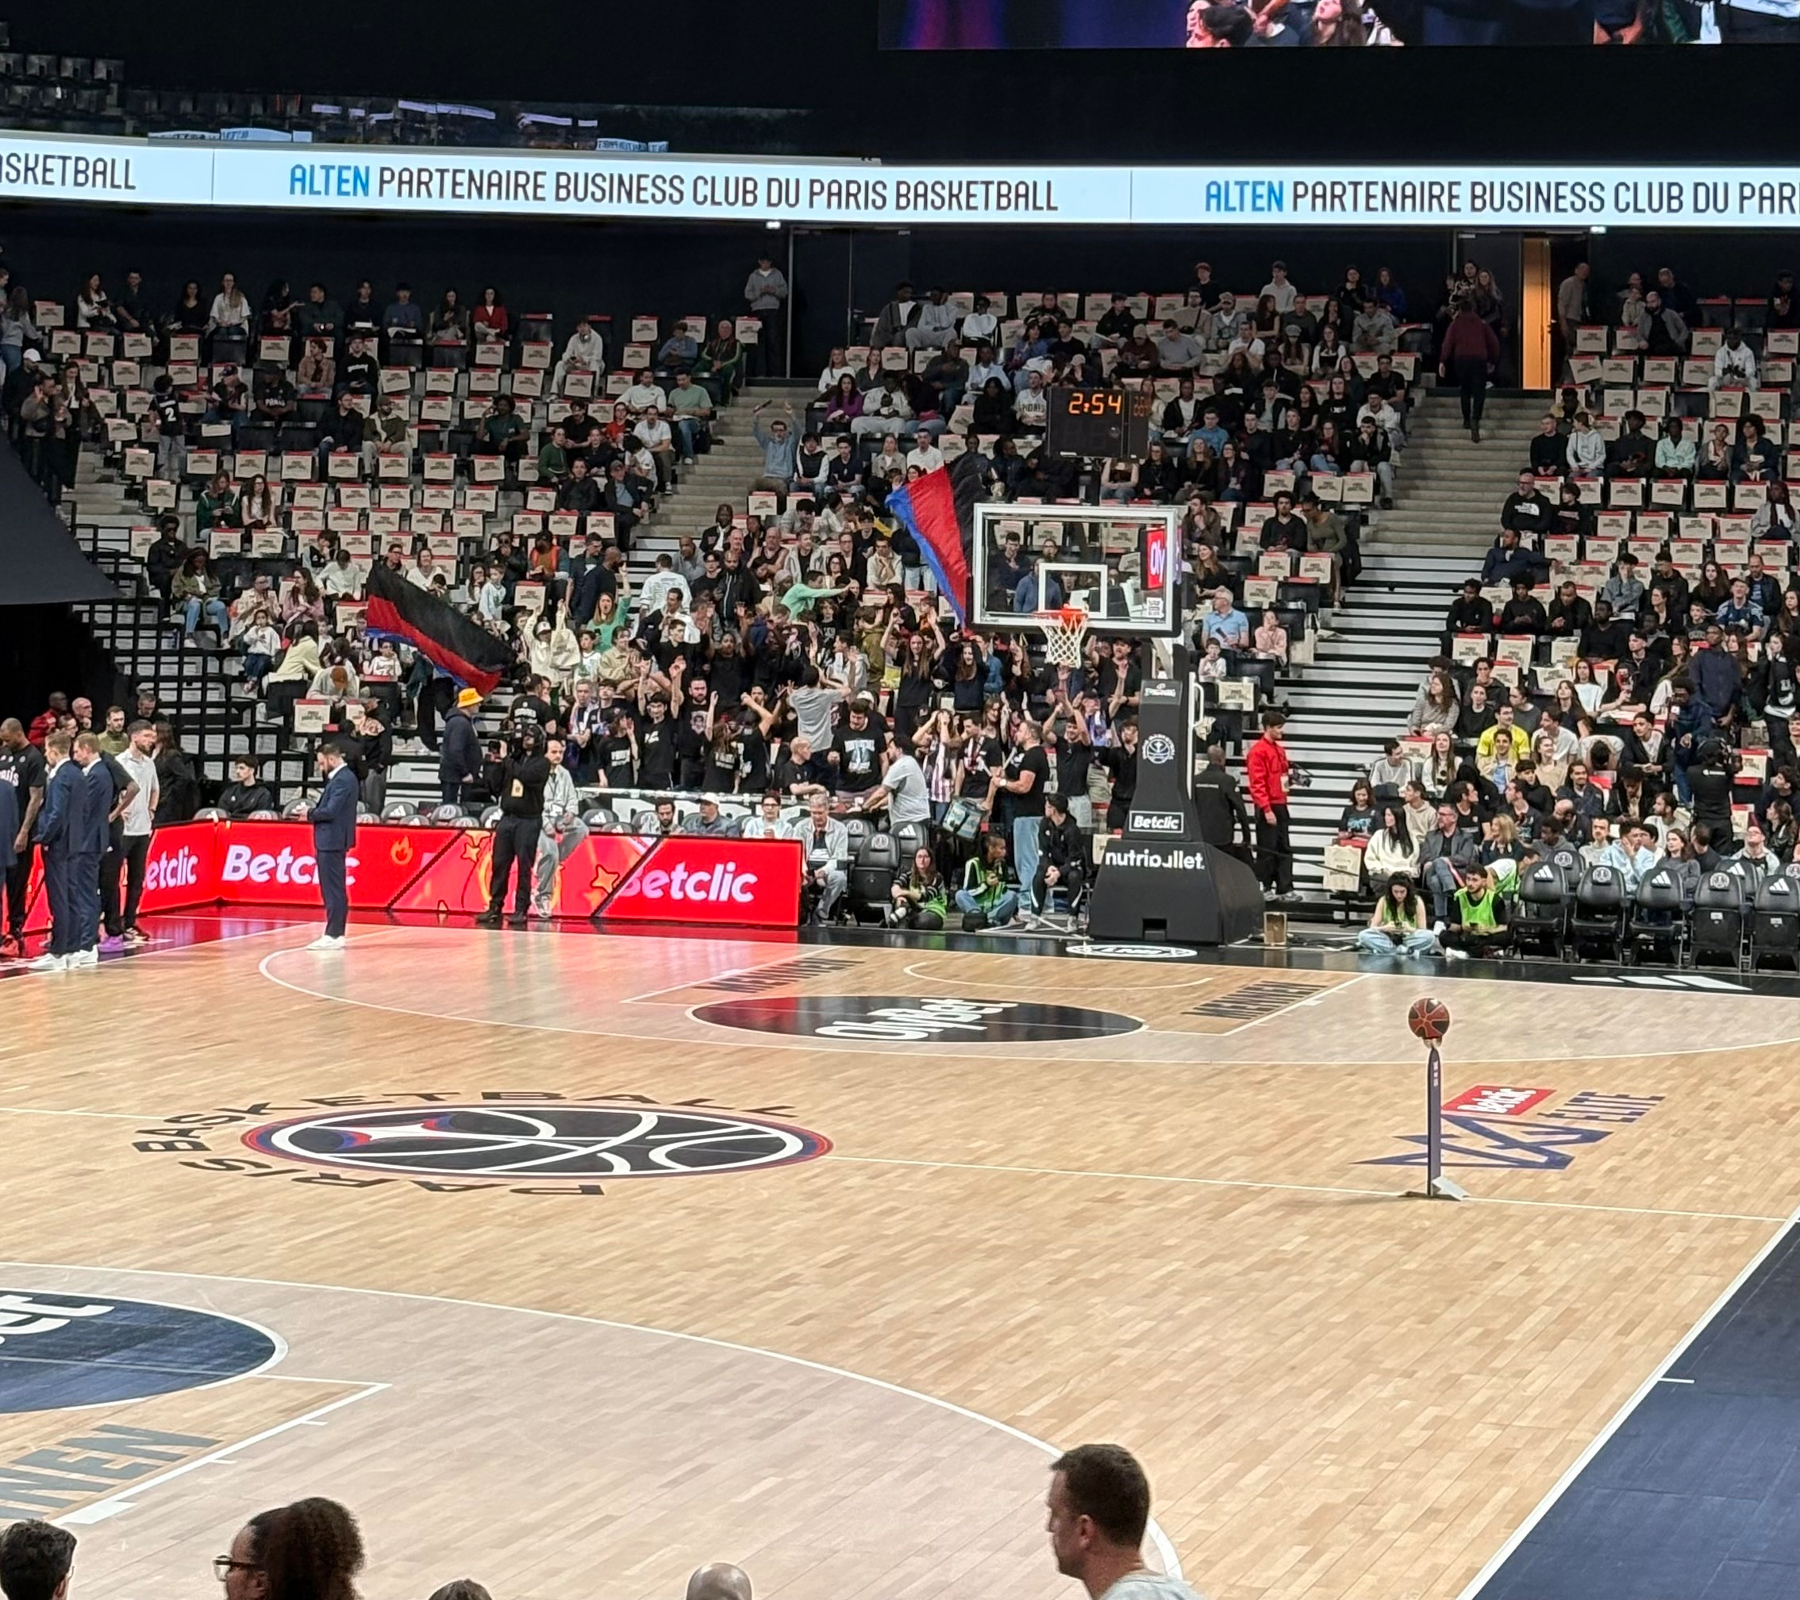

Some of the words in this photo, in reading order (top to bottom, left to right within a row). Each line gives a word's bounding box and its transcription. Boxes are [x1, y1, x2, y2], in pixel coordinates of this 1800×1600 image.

[0, 153, 136, 190] SKETBALL
[289, 164, 370, 197] ALTEN
[378, 167, 547, 202] PARTENAIRE
[554, 171, 685, 205] BUSINESS
[692, 175, 758, 208] CLUB
[766, 177, 800, 209] DU
[808, 178, 888, 211] PARIS
[895, 180, 1059, 212] BASKETBALL
[1205, 180, 1284, 213] ALTEN
[1292, 180, 1462, 213] PARTENAIRE
[1470, 180, 1605, 213] BUSINESS
[1614, 181, 1684, 214] CLUB
[1692, 181, 1729, 214] DU
[164, 407, 177, 421] 2
[1068, 392, 1122, 415] 2:54
[1133, 815, 1179, 830] Betclic
[143, 846, 198, 891] etclic
[815, 998, 1018, 1040] OlyBet
[1456, 1088, 1538, 1114] Betclic
[1538, 1091, 1667, 1124] ELITE
[134, 1091, 798, 1155] BASKETBALL
[178, 1157, 605, 1197] PARIS
